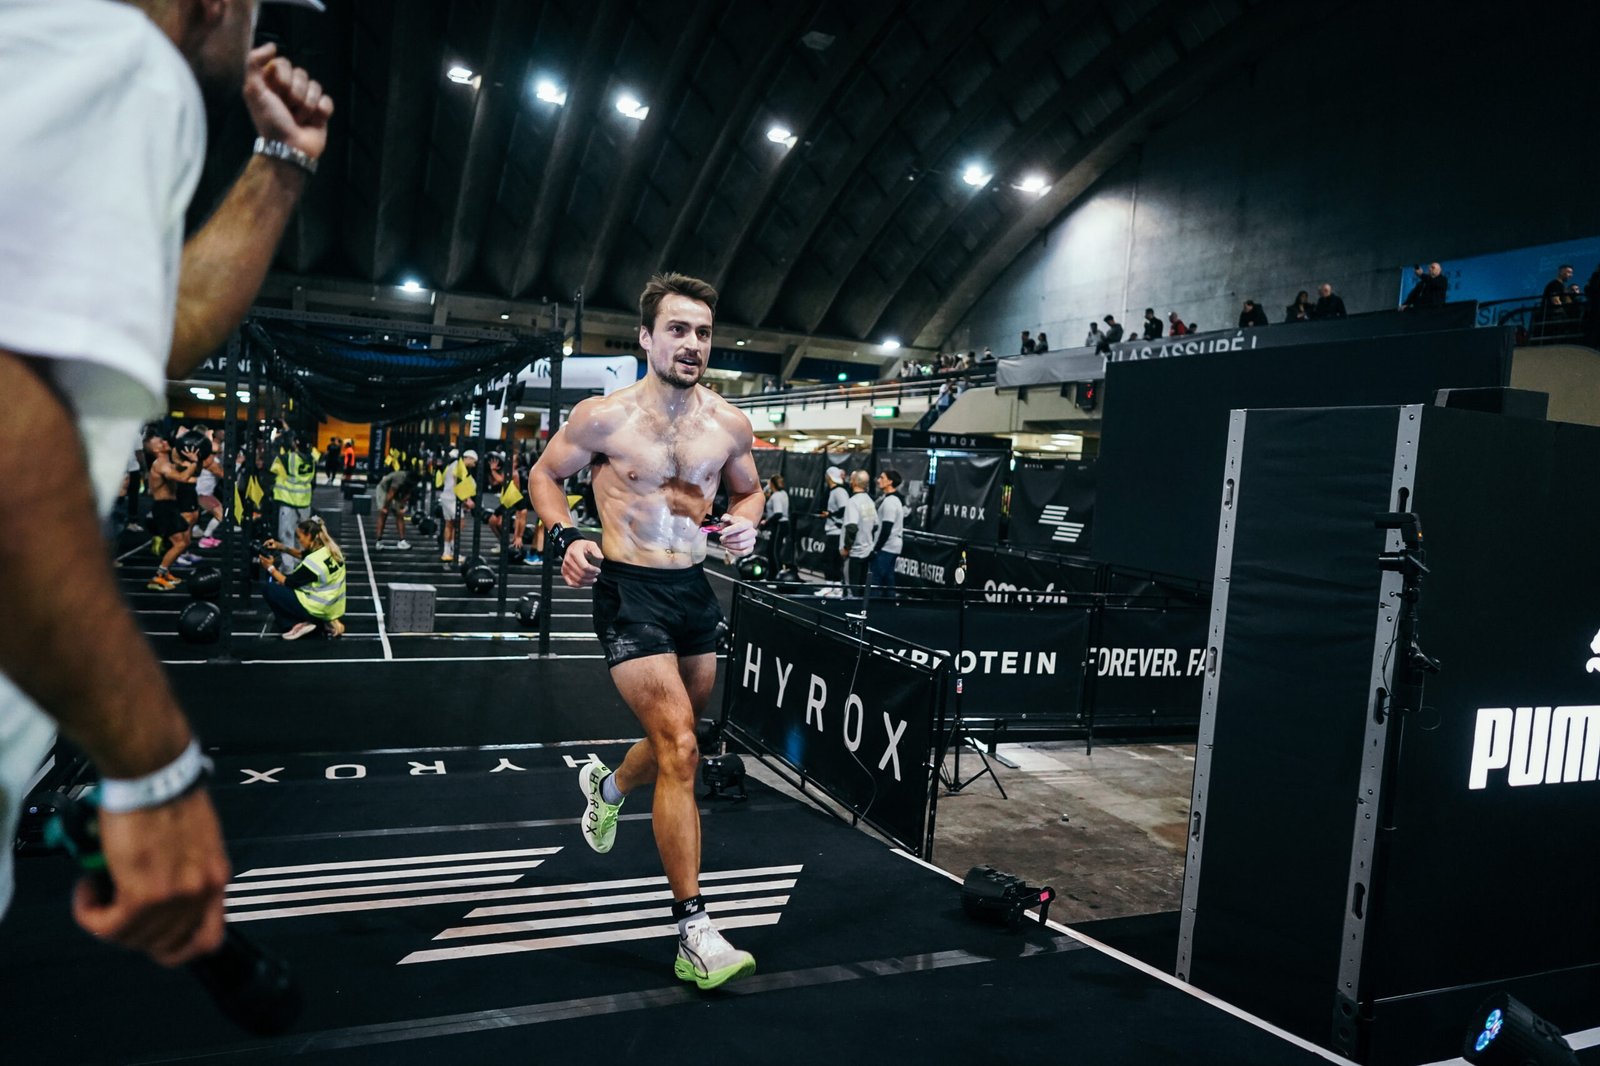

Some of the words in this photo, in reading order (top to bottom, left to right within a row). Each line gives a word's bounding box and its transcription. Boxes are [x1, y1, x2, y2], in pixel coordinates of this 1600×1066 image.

[929, 434, 977, 447] HYROX
[943, 503, 985, 521] HYROX
[894, 556, 921, 578] OREVER.
[742, 641, 908, 782] HYROX
[1468, 704, 1600, 790] PUM
[239, 752, 600, 785] HYROX
[585, 772, 600, 836] HYROX
